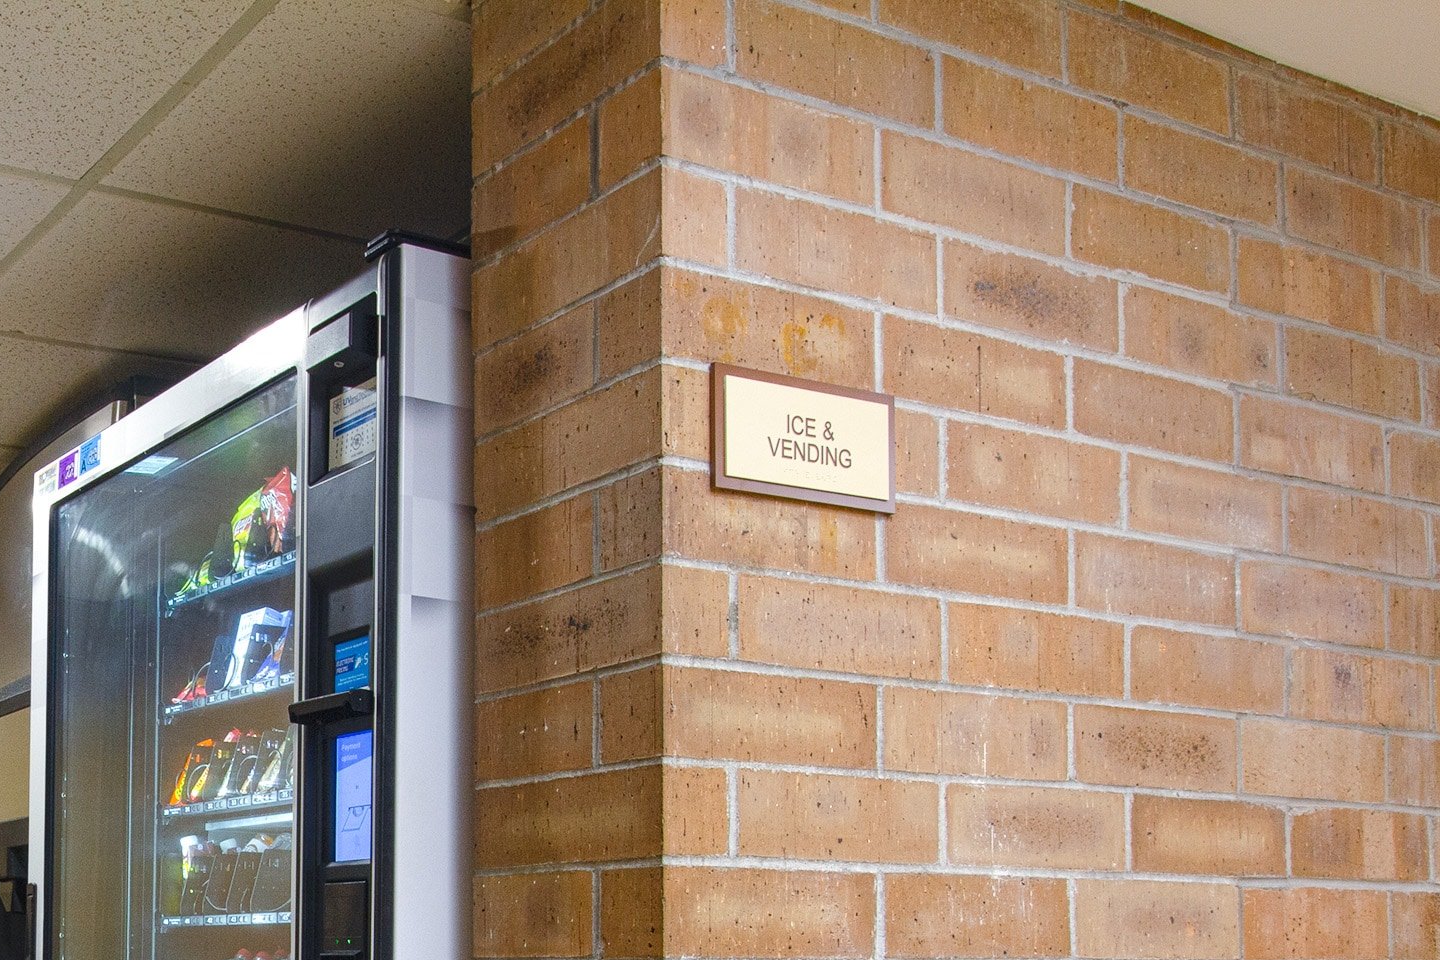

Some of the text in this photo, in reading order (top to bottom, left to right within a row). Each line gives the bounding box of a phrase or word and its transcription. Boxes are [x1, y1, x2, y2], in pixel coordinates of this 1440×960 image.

[786, 414, 835, 441] ICE &
[767, 436, 853, 469] VENDING
